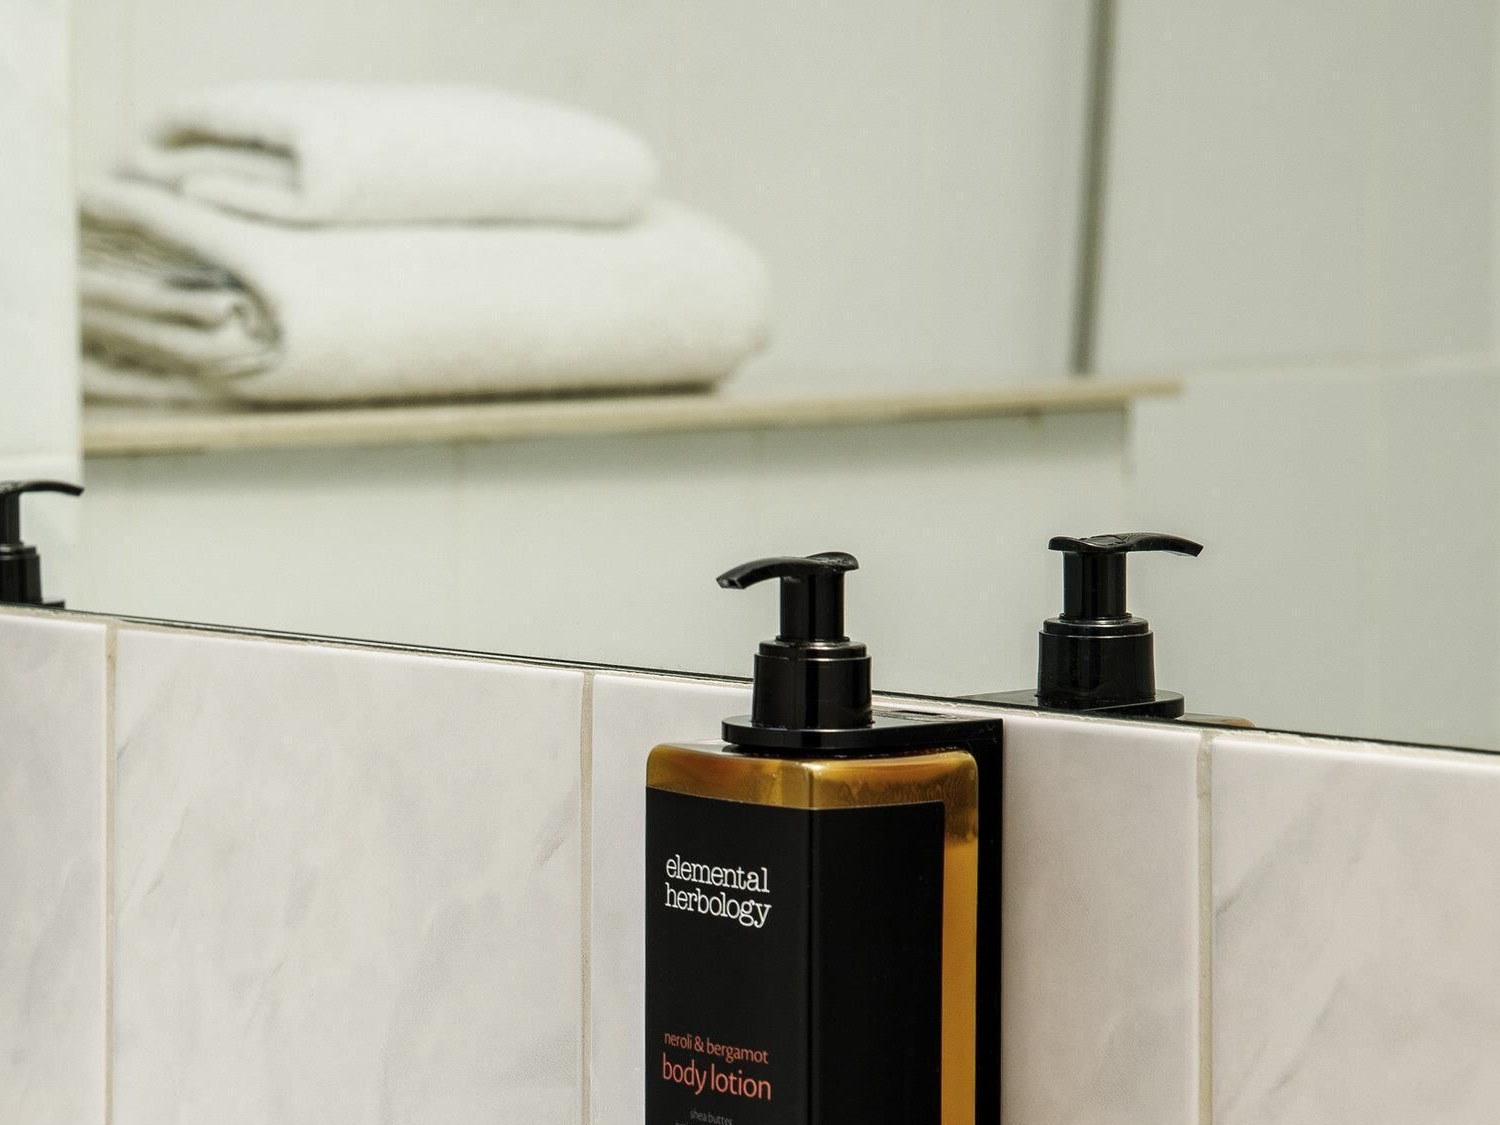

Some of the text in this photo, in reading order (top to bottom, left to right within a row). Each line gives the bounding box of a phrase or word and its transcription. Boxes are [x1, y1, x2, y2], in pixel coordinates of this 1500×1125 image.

[665, 854, 770, 893] elemental
[664, 882, 772, 928] herbology
[664, 1032, 770, 1064] neroli & bergamot
[662, 1052, 771, 1100] body lotion
[690, 1107, 707, 1122] shea
